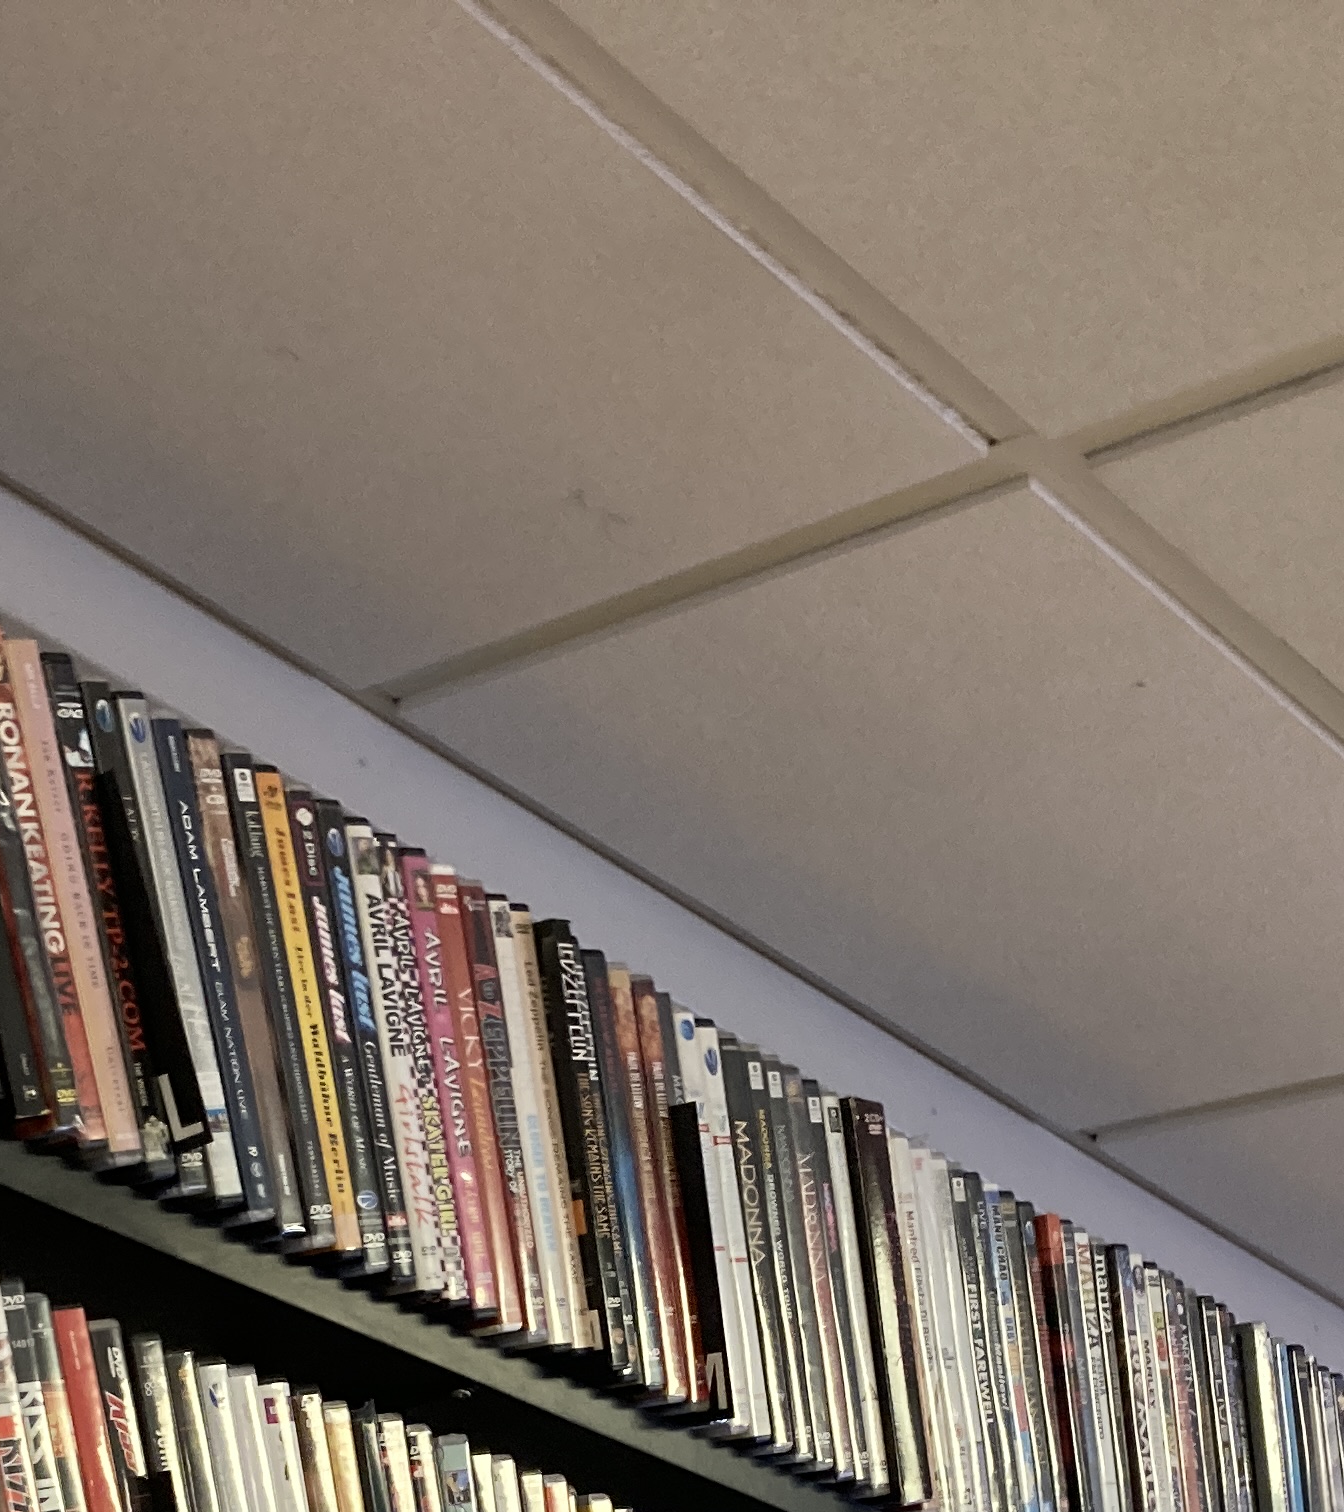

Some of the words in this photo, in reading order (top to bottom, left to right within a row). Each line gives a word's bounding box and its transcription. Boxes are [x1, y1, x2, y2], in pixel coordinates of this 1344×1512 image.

[19, 814, 67, 954] KEATING
[178, 800, 200, 861] ADAM
[192, 867, 222, 974] LAMBERT
[364, 893, 391, 960] AVRIL
[377, 961, 410, 1060] LAVIGNE
[424, 930, 448, 1013] AVRIL
[438, 1035, 472, 1160] LAVIGNE
[457, 987, 484, 1072] VICKY
[158, 1073, 205, 1143] L
[362, 1040, 385, 1131] Gentleman
[378, 1131, 391, 1153] of
[382, 1154, 397, 1204] Music
[734, 1119, 767, 1269] MADONNA
[1093, 1251, 1114, 1334] mariza
[973, 1337, 996, 1425] FAREWELL
